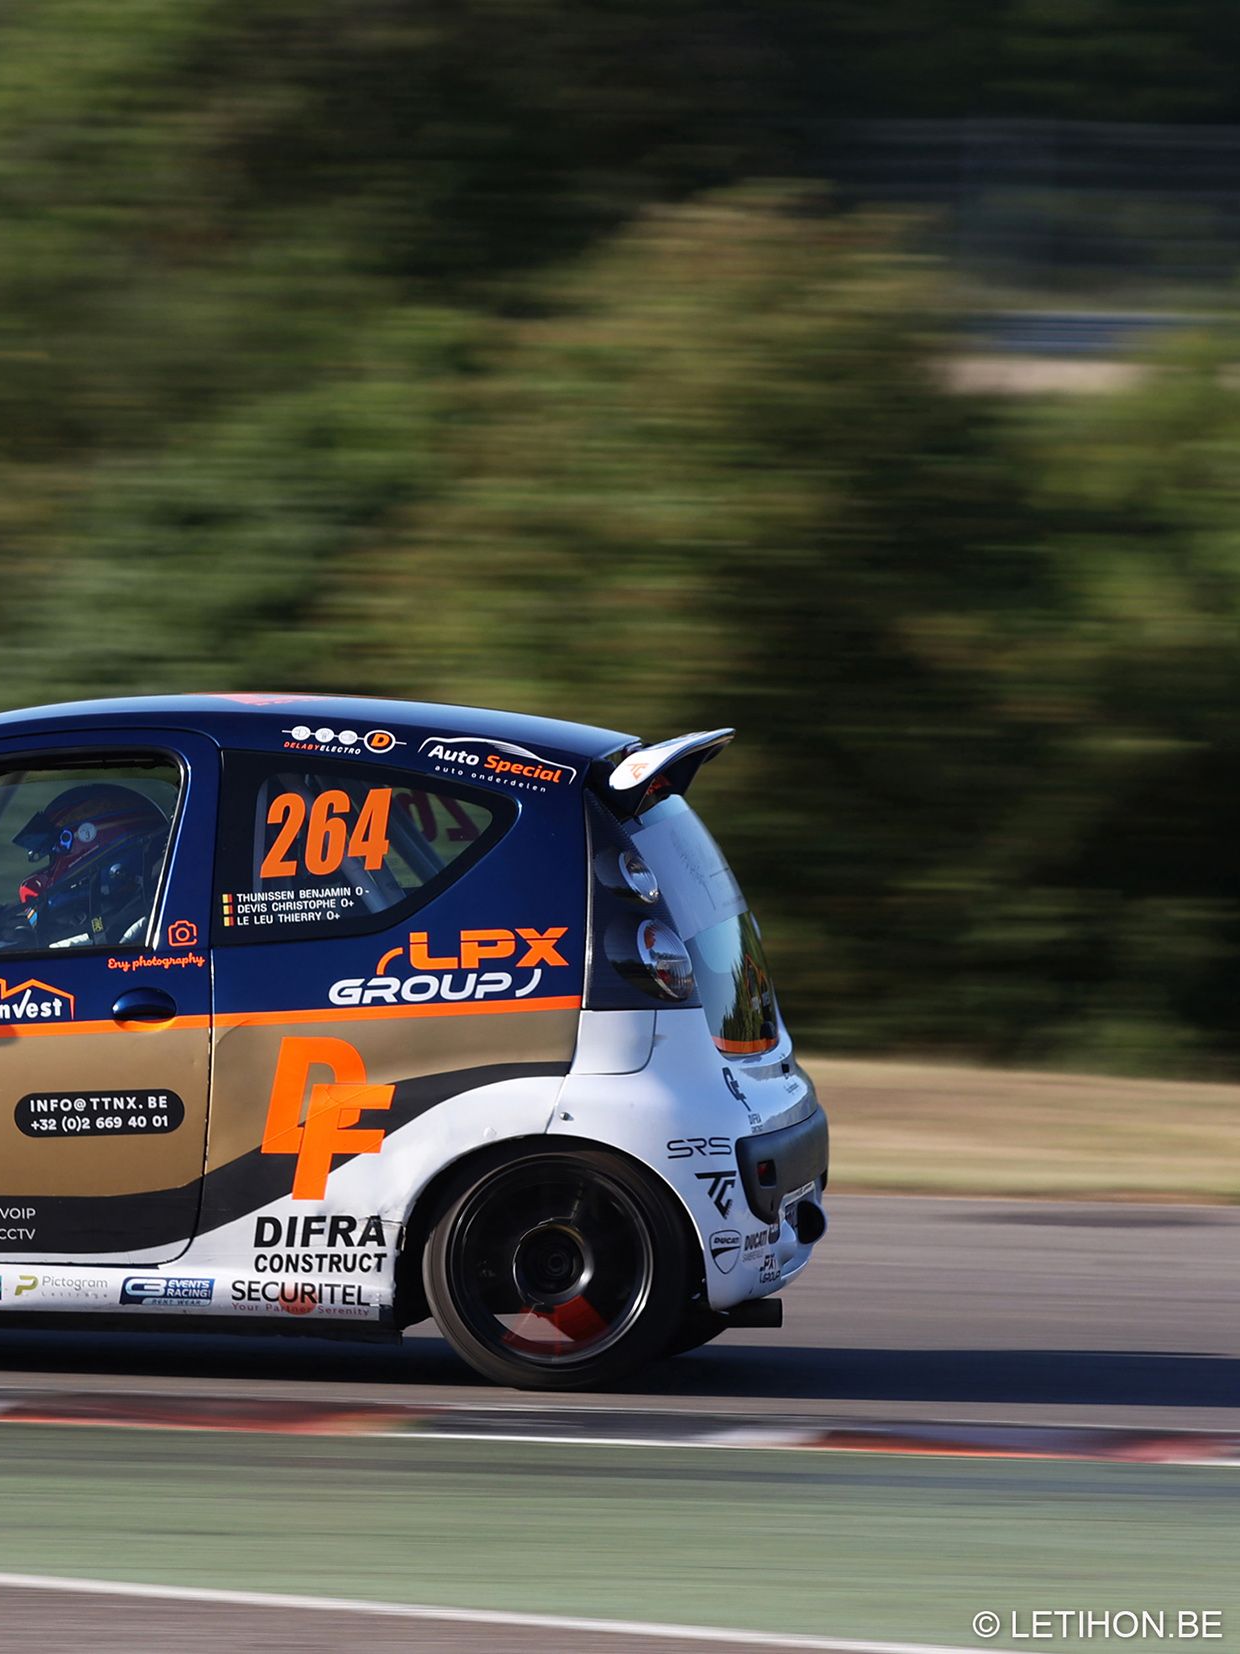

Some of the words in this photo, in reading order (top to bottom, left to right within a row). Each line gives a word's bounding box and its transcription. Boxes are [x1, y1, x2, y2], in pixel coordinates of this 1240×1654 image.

[428, 745, 480, 766] Auto
[484, 755, 562, 783] Special
[435, 765, 463, 776] auto
[471, 772, 546, 793] onderdelen
[260, 787, 392, 879] 264
[236, 890, 295, 904] THUNISSEN
[299, 887, 352, 899] BENJAMIN
[237, 903, 267, 914] DEVIS
[271, 899, 337, 912] CHRISTOPHE
[237, 916, 249, 926] LE
[254, 915, 273, 925] LEU
[278, 912, 322, 923] THIERRY
[409, 927, 570, 970] LPX
[132, 952, 205, 971] photography
[328, 972, 513, 1006] GROUP
[30, 1119, 57, 1131] +32
[61, 1115, 91, 1132] (0)2
[95, 1116, 123, 1129] 669
[128, 1115, 147, 1128] 40
[152, 1115, 168, 1127] 01
[666, 1137, 733, 1158] SRS
[0, 1207, 36, 1220] VOIP
[254, 1215, 387, 1248] DIFRA
[254, 1253, 388, 1274] CONSTRUCT
[41, 1275, 108, 1291] Pictogram
[168, 1279, 210, 1289] EVENTS
[166, 1288, 208, 1298] RACING
[231, 1280, 370, 1307] SECURITEL
[231, 1302, 259, 1312] Your
[266, 1304, 314, 1314] Partner
[318, 1305, 369, 1316] Serenity
